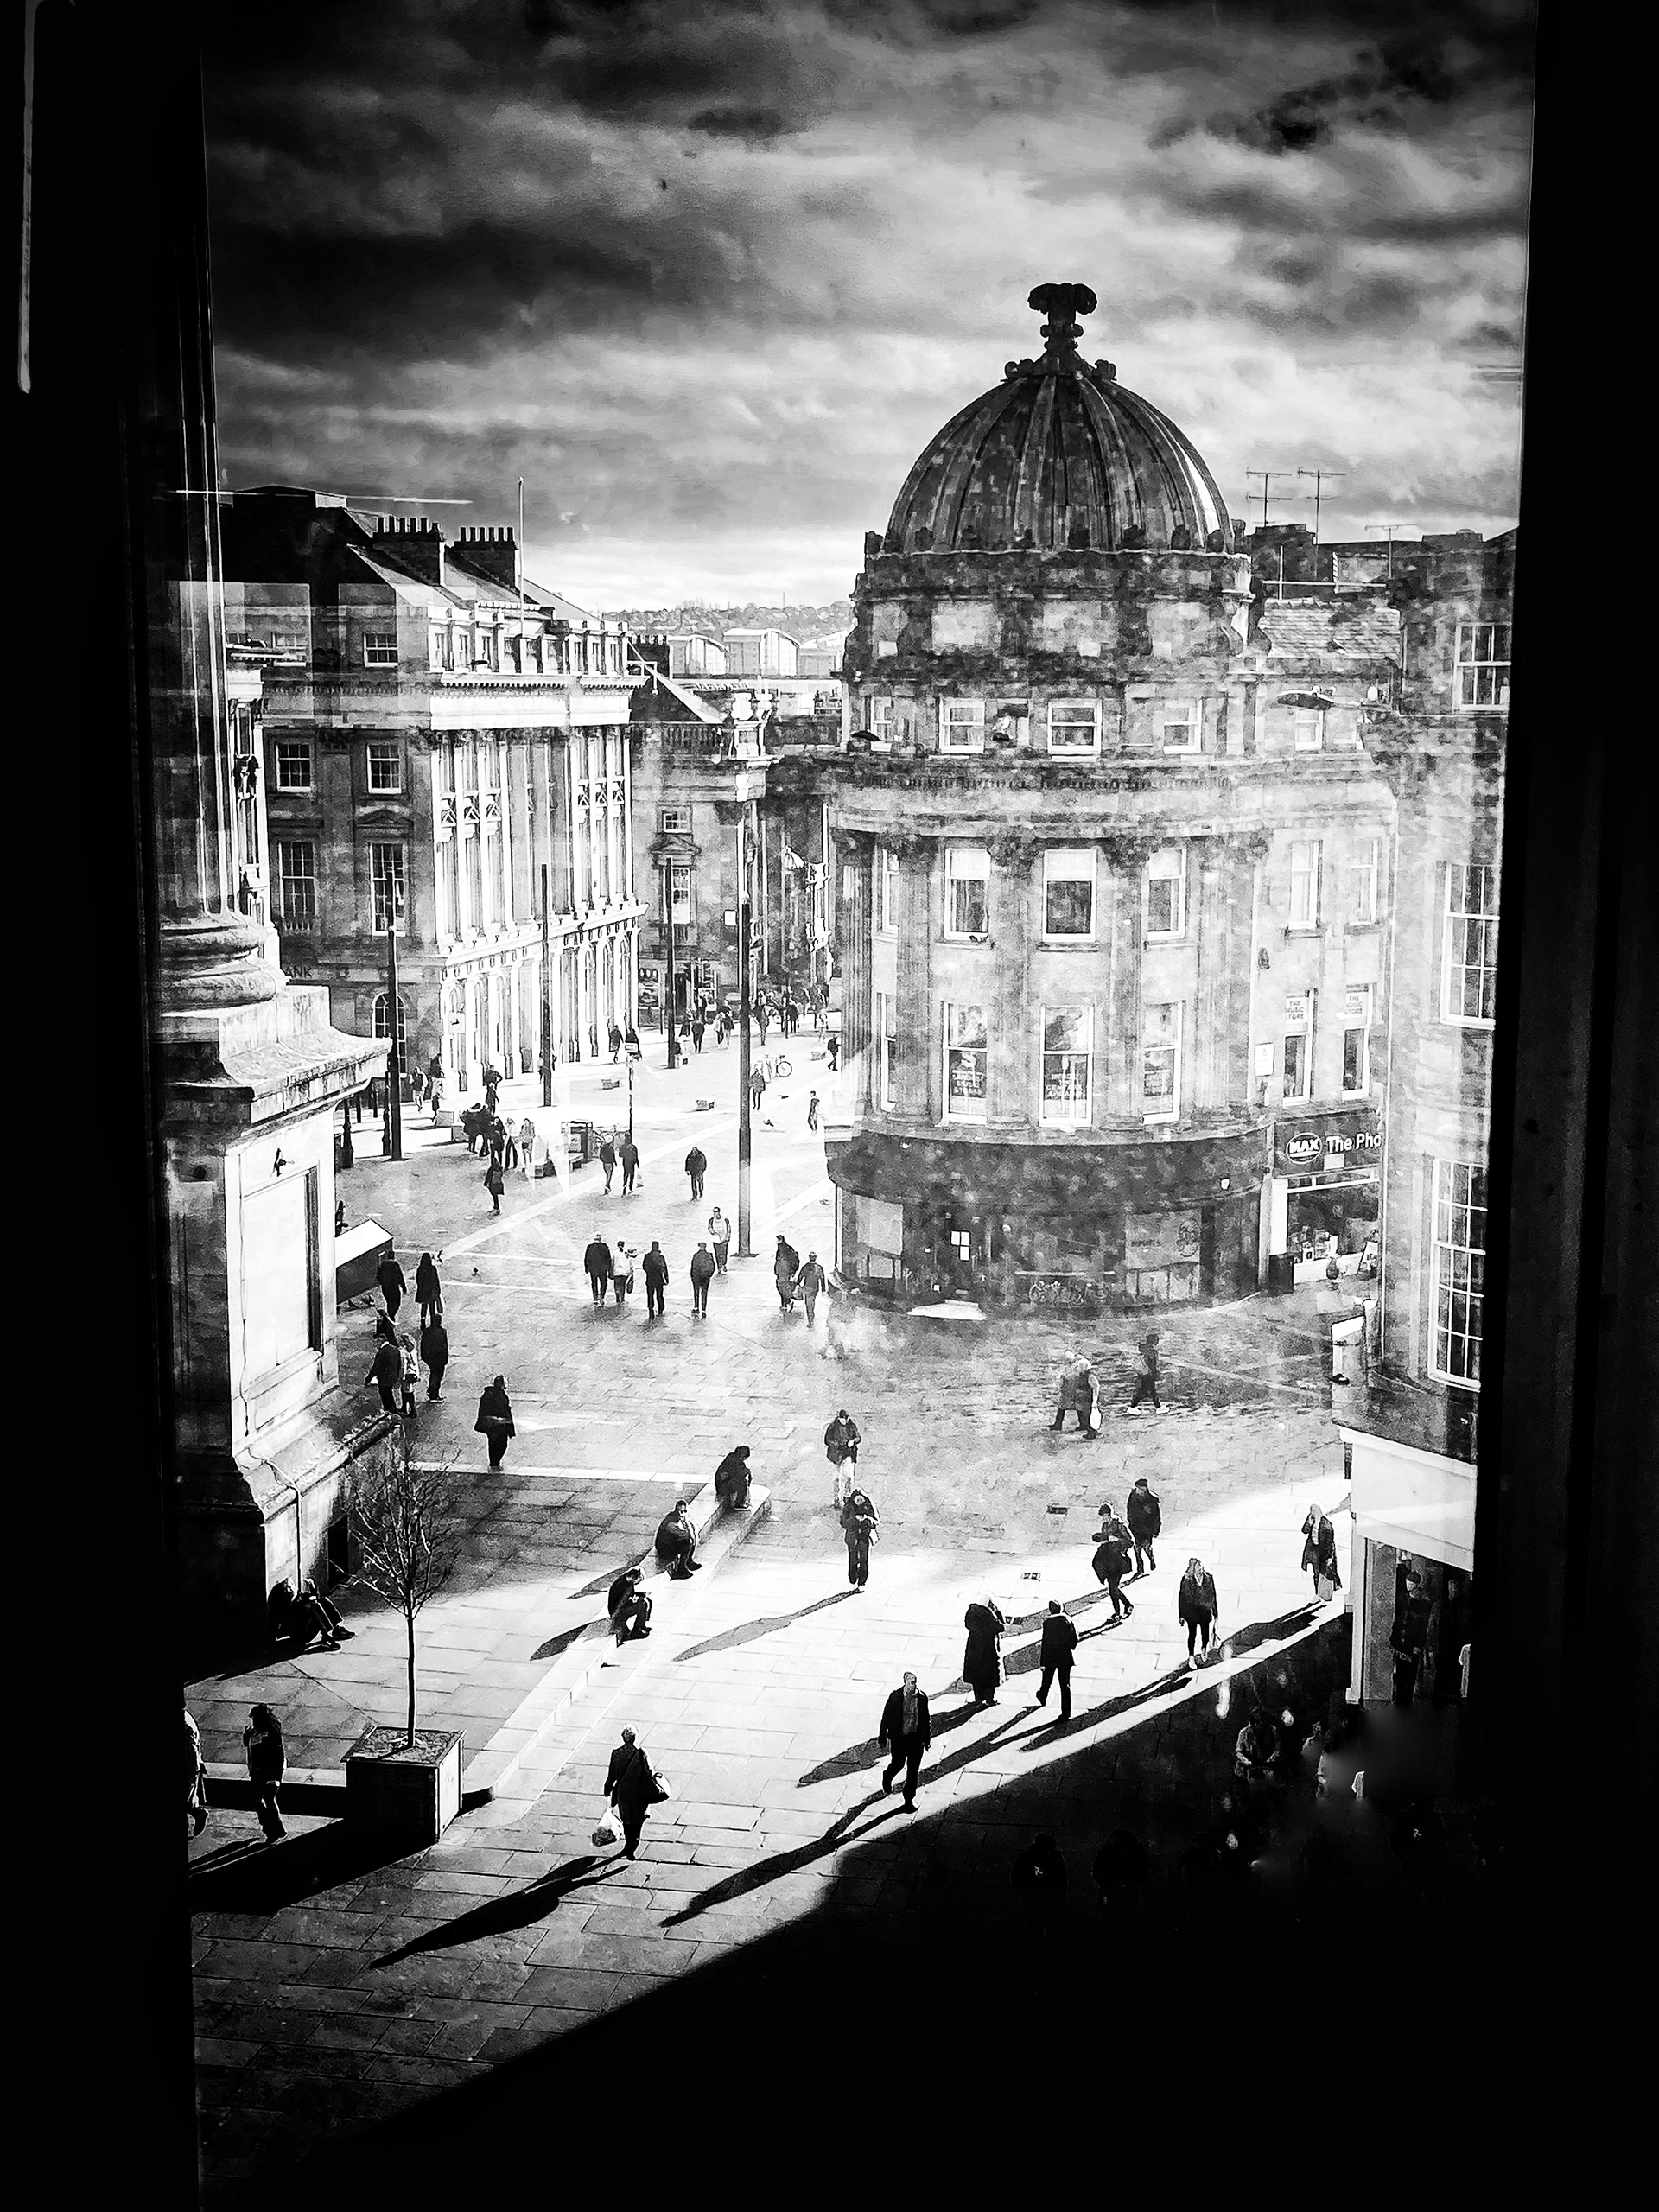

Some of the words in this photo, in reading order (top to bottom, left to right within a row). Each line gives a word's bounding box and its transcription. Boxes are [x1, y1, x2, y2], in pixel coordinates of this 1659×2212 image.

[1289, 1138, 1319, 1154] MAX
[1326, 1135, 1353, 1154] The
[1356, 1131, 1382, 1150] Pho
